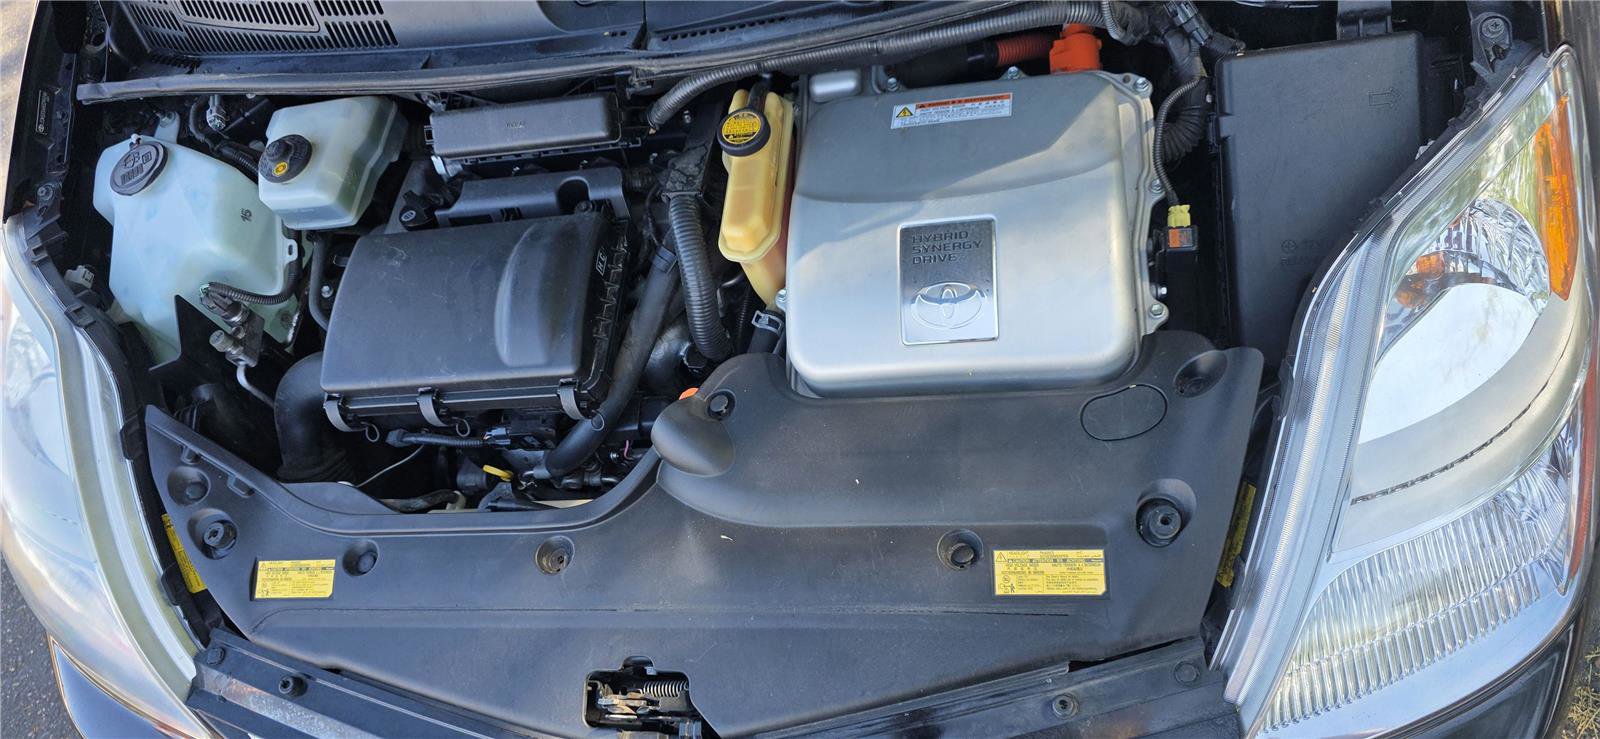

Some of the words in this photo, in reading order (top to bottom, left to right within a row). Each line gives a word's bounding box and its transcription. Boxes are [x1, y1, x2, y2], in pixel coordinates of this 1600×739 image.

[912, 231, 969, 243] HYBRID
[912, 240, 983, 254] SYNERGY
[912, 254, 957, 265] DRIVE
